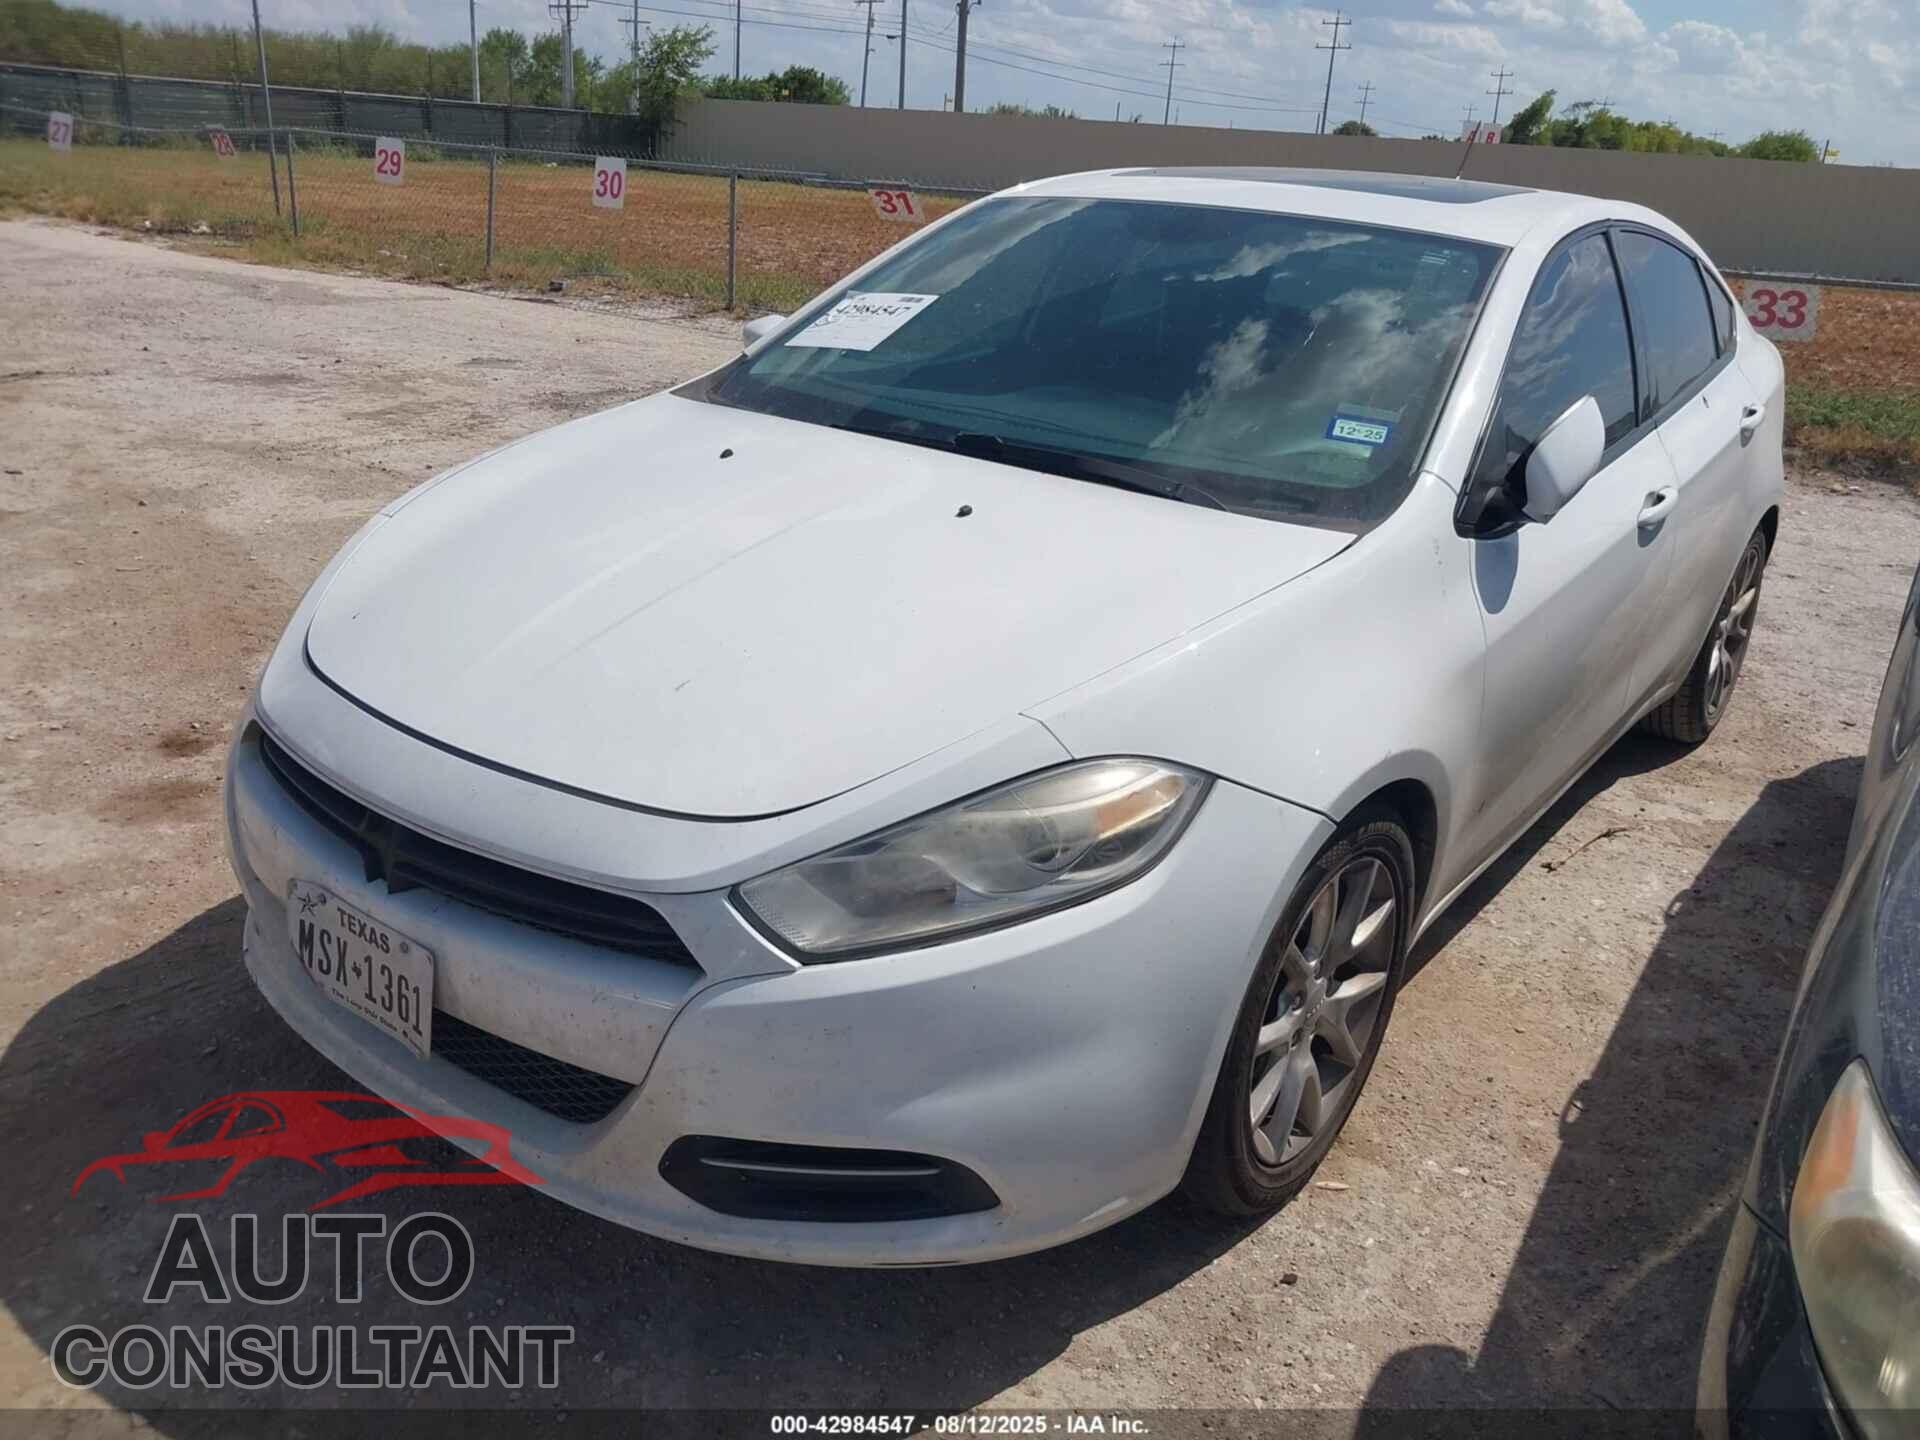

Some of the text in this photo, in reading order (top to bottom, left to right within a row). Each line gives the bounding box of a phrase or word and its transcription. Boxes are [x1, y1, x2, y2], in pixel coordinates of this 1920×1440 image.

[50, 120, 71, 144] 27
[376, 148, 401, 177] 29
[595, 169, 622, 199] 30
[874, 190, 914, 216] 31
[1747, 288, 1808, 329] 33
[336, 906, 391, 955] TEXAS
